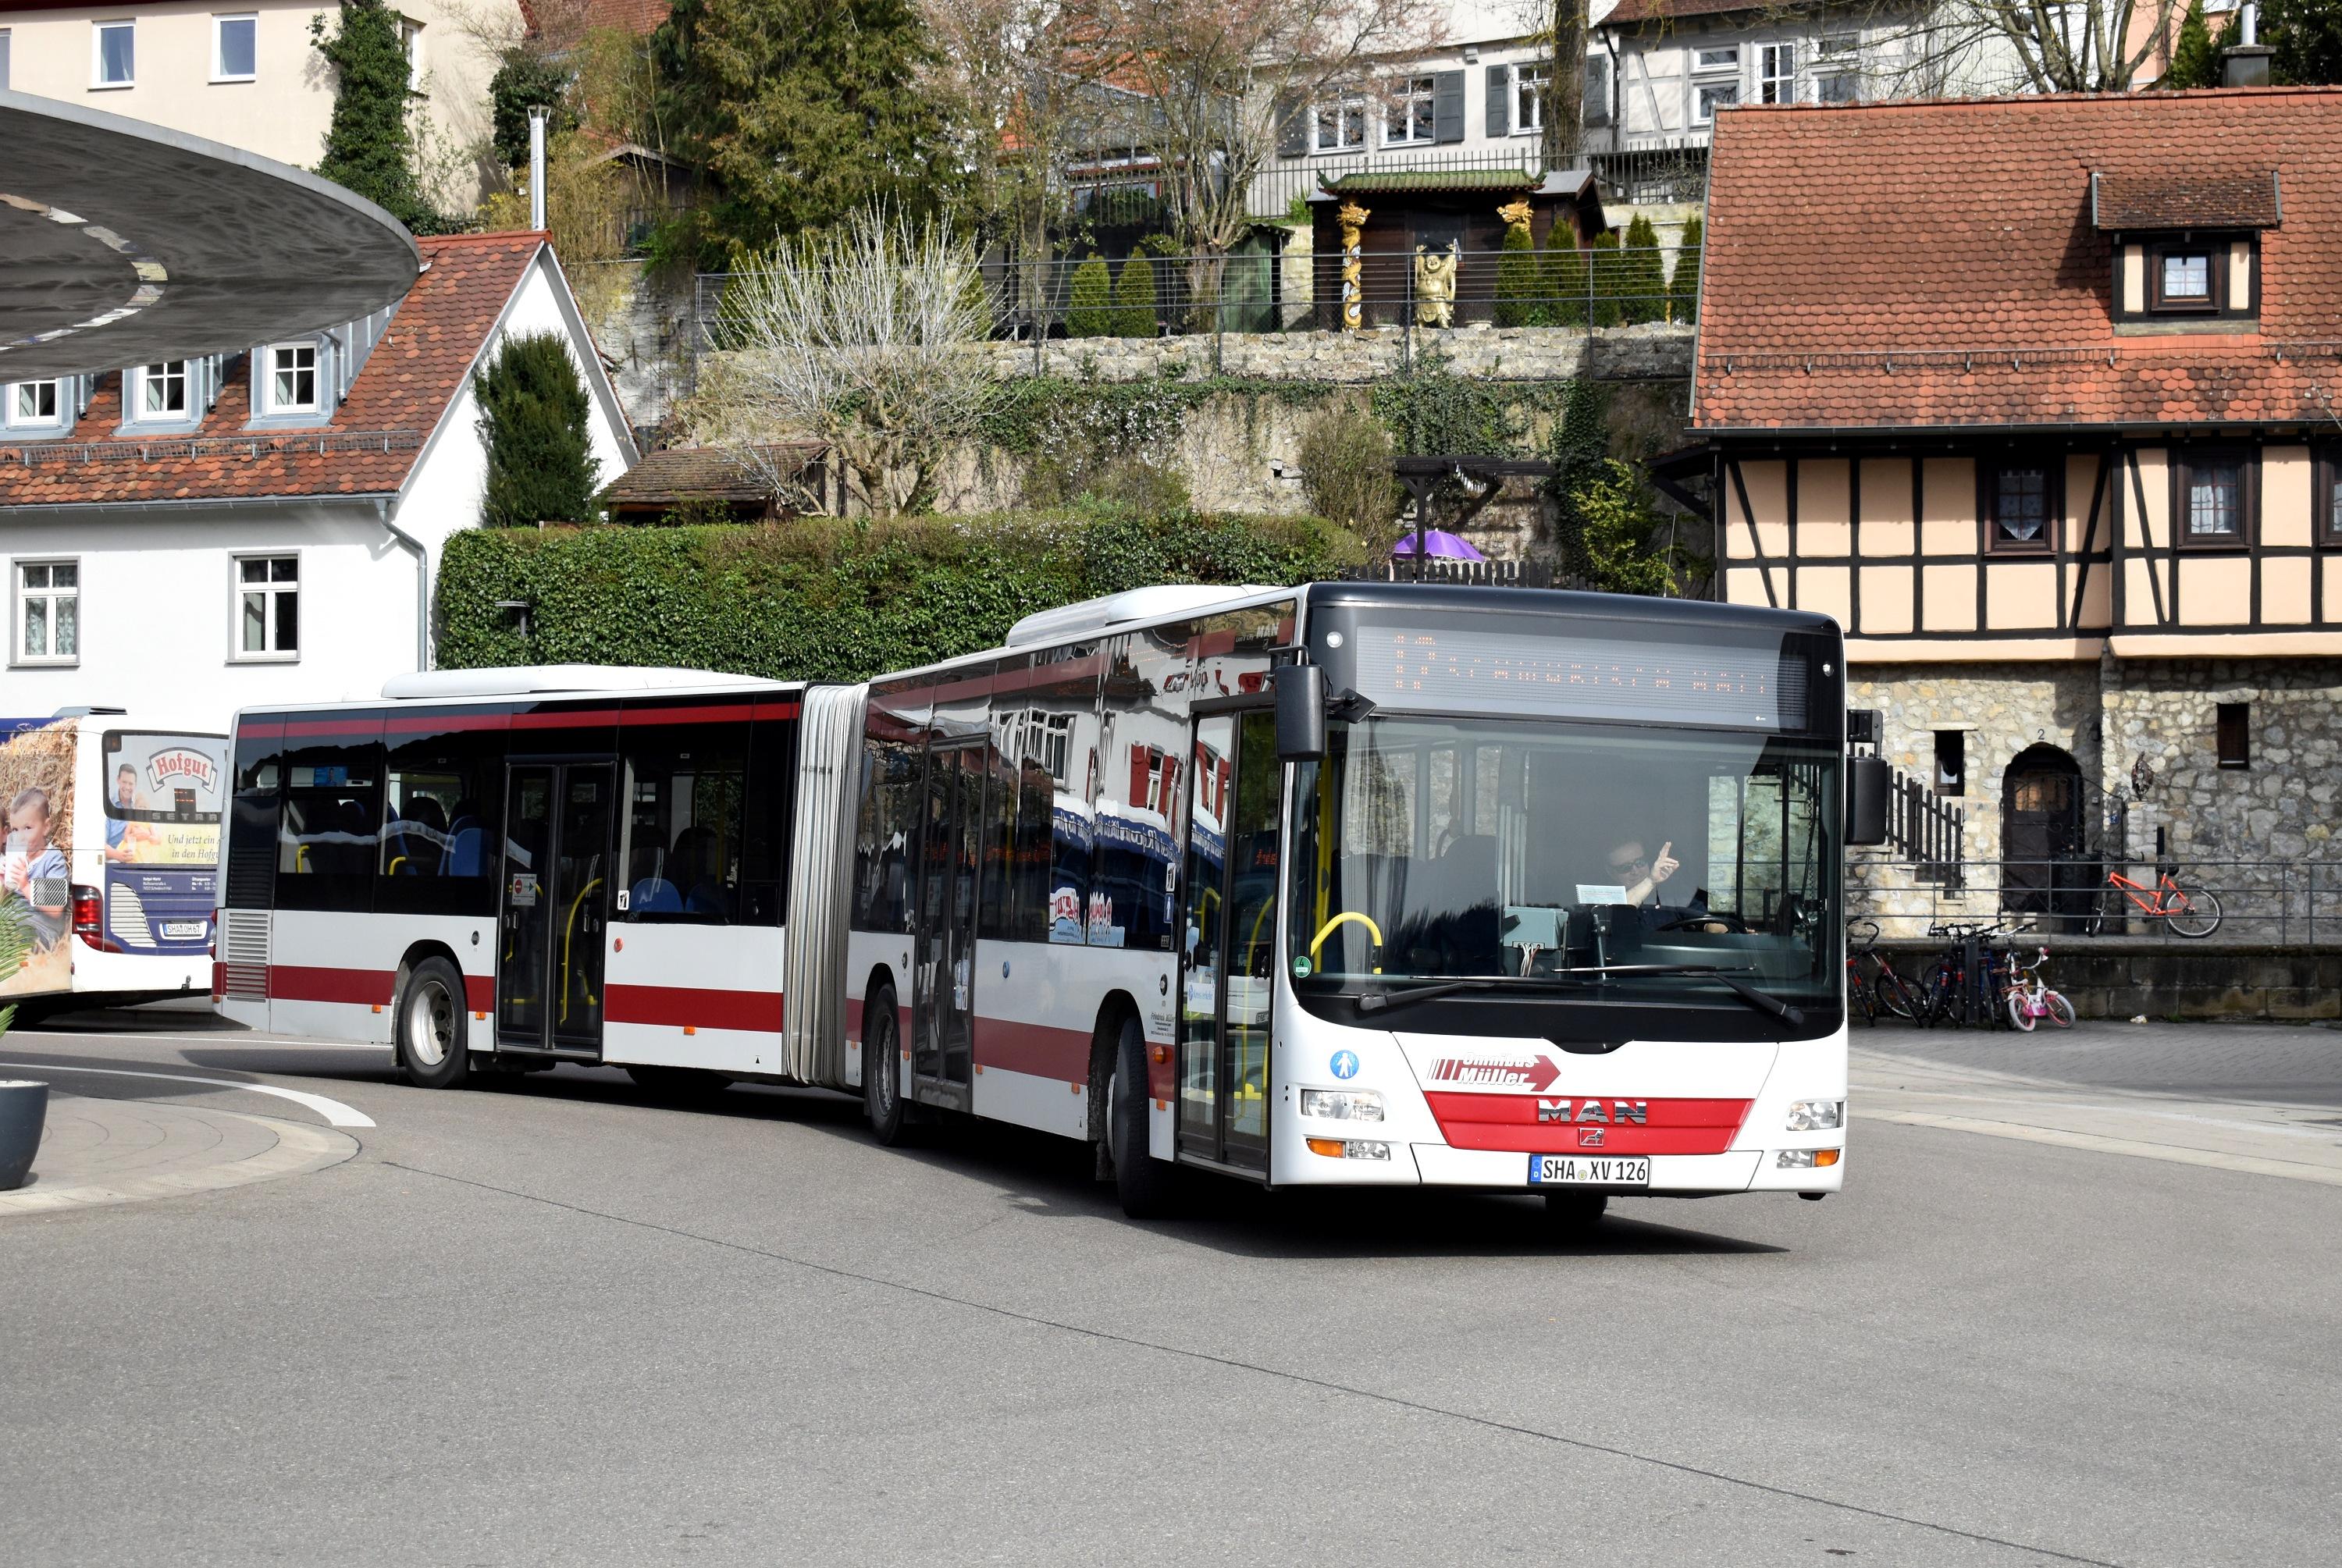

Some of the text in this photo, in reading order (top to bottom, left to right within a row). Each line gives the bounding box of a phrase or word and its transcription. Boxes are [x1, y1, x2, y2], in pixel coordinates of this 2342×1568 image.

[1256, 623, 1280, 638] MAN
[2037, 729, 2045, 740] 2
[155, 752, 208, 777] Hofgut
[168, 834, 215, 847] Und jetzt ein
[172, 850, 181, 859] in
[182, 849, 196, 859] den
[167, 925, 180, 933] SHA
[193, 924, 200, 933] 67
[1299, 958, 1304, 967] 4
[1462, 1052, 1537, 1068] Omnibus
[1457, 1067, 1530, 1086] Müller
[1538, 1099, 1647, 1124] MAN
[1543, 1160, 1575, 1180] SHA
[1590, 1161, 1611, 1180] XV
[1616, 1161, 1646, 1181] 126
